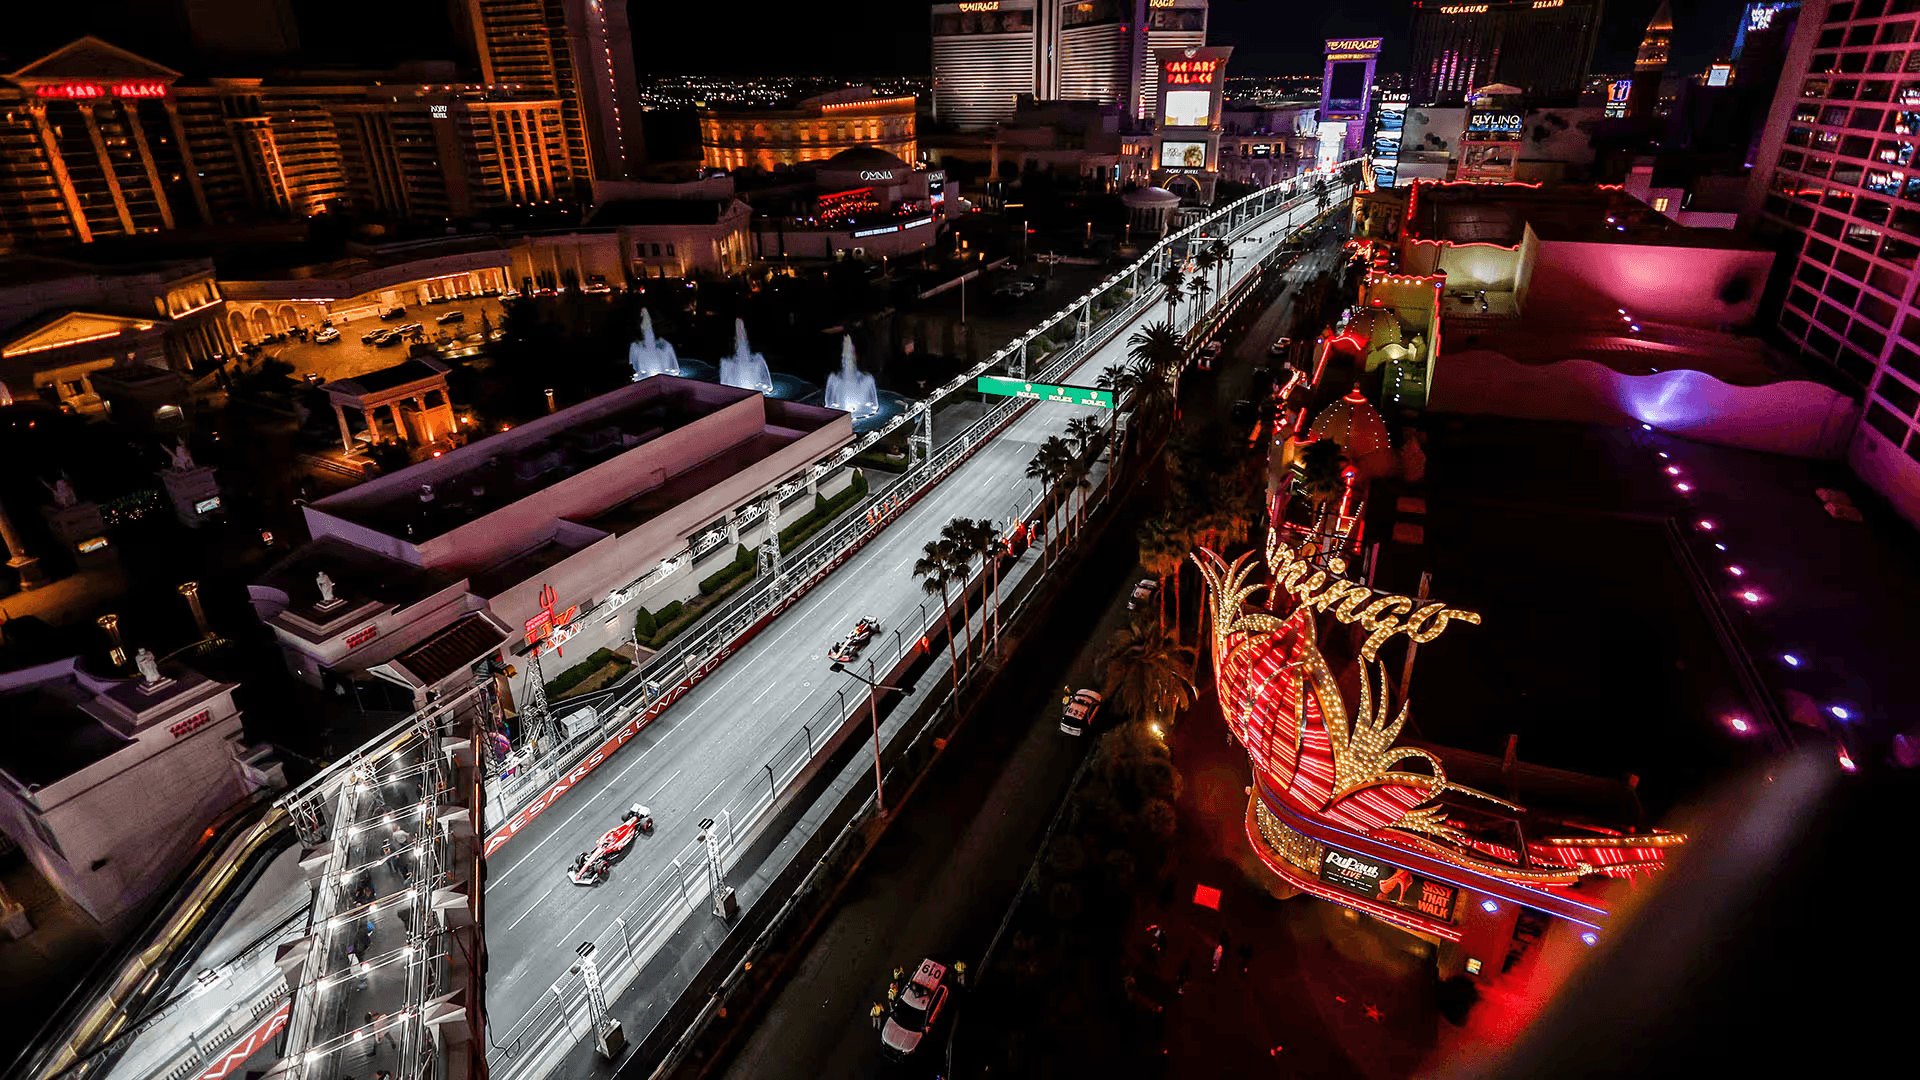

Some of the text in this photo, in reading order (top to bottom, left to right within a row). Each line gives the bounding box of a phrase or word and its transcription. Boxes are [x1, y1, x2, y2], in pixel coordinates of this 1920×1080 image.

[961, 1, 999, 12] MIRAGE
[1440, 0, 1564, 15] TREASURE ISLAND
[1330, 40, 1380, 51] MIRAGE
[1165, 60, 1217, 73] CAESARS
[1166, 73, 1214, 85] PALACE
[111, 84, 166, 97] PALACE
[1382, 93, 1408, 101] LINQ
[860, 170, 893, 181] OMNIA
[1016, 390, 1040, 400] ROLEX
[1048, 394, 1073, 403] ROLEX
[1081, 398, 1107, 408] ROLEX
[932, 447, 976, 485] CAESARS
[771, 500, 912, 618] CAESARS REWARDS
[484, 645, 732, 858] AESARS REWARDS
[1340, 868, 1361, 880] LIVE
[1422, 880, 1454, 899] SISSY
[1422, 890, 1451, 908] THAT
[1417, 899, 1449, 919] WALK
